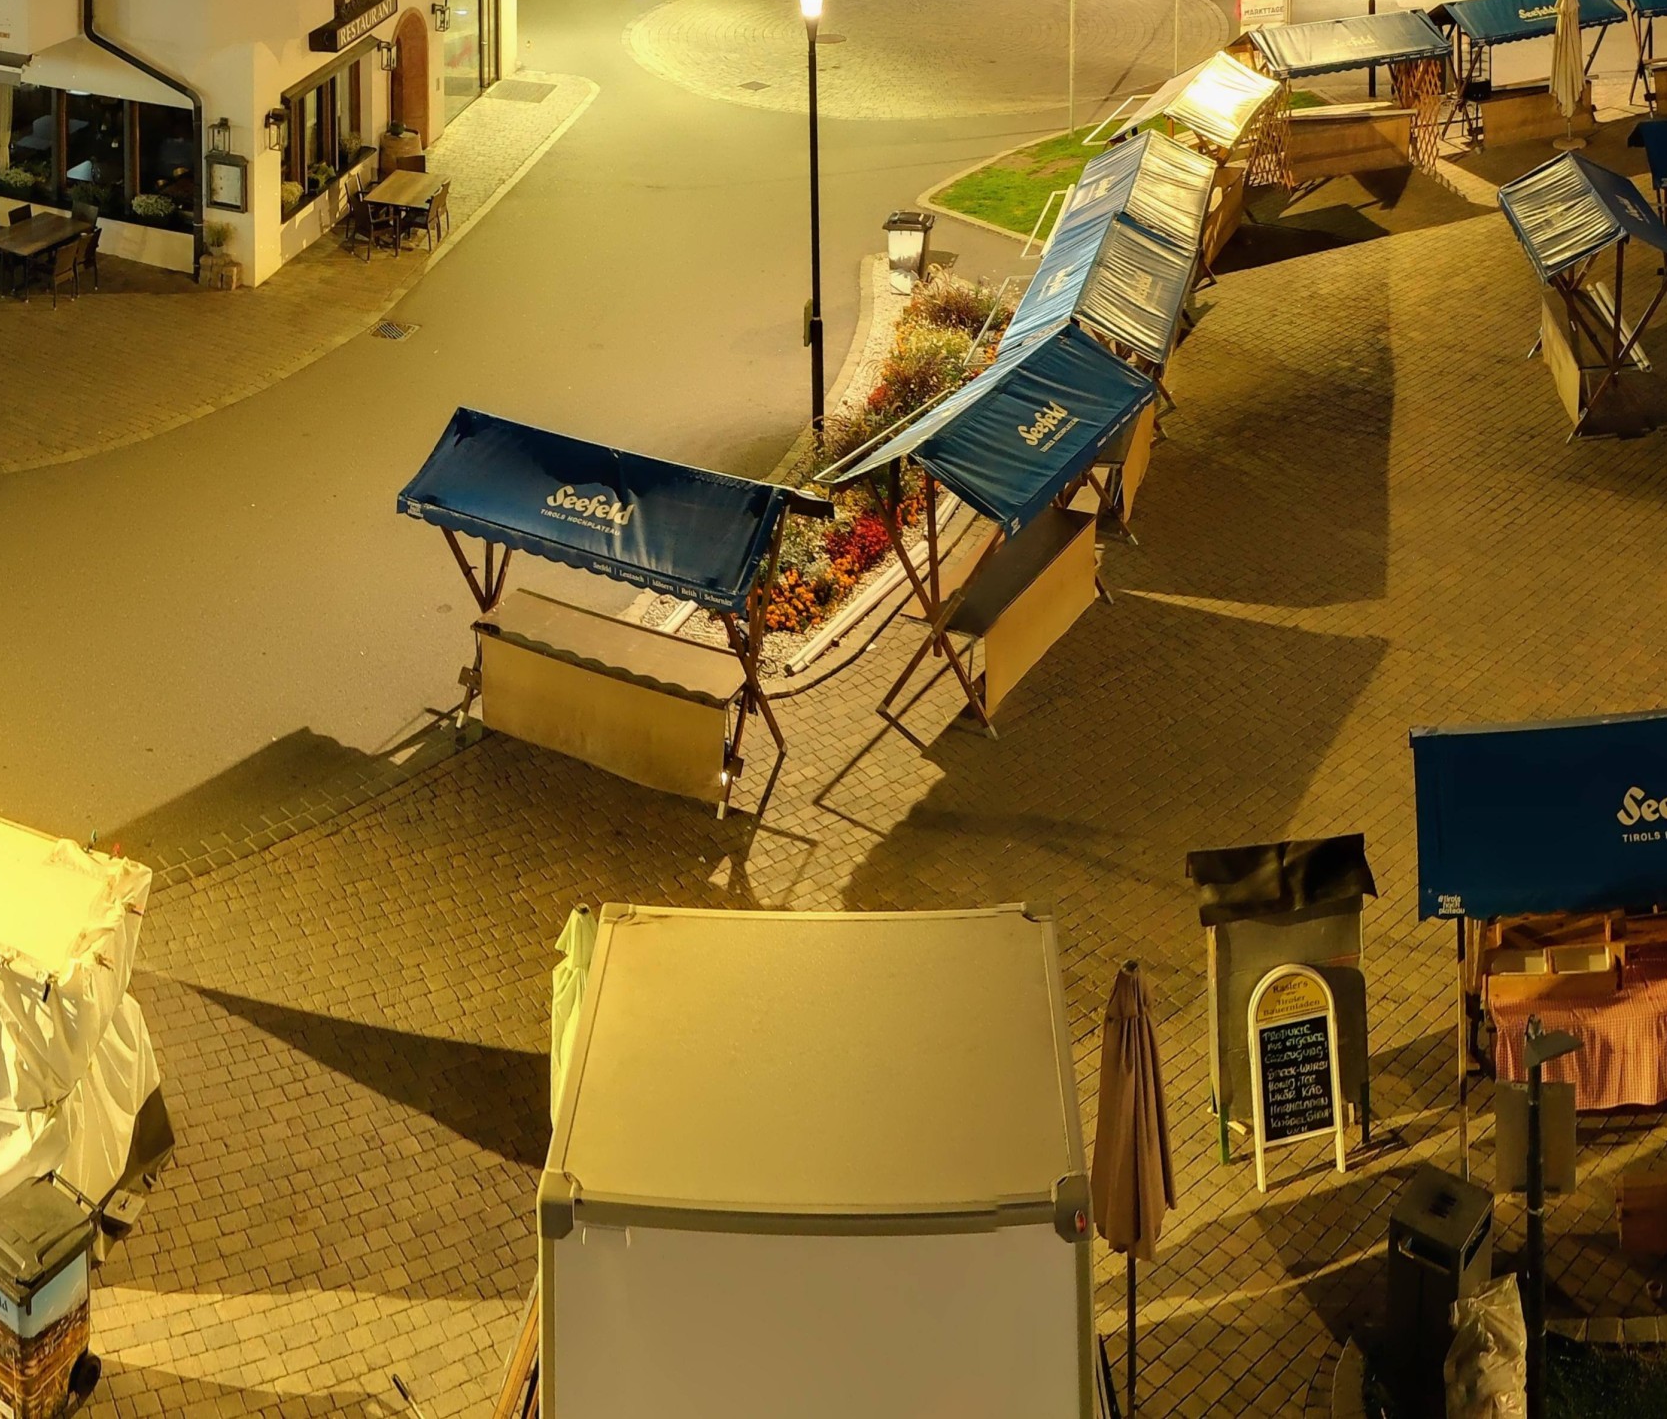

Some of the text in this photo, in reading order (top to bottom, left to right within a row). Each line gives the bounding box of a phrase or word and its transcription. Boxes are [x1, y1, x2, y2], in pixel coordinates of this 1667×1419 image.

[1244, 6, 1285, 16] MARKTTAGE
[1518, 5, 1558, 19] Seefeld
[1017, 400, 1068, 446] Seefeld
[546, 484, 635, 526] Seefeld
[540, 508, 621, 536] TIROLS HOCHPLATEAU
[619, 569, 645, 584] Leutasch
[681, 586, 697, 598] Reith
[1622, 831, 1661, 843] TIROLS
[1437, 894, 1462, 903] #tirols
[1263, 999, 1320, 1016] Bauernladen
[1276, 995, 1306, 1006] Tiroler
[1262, 1024, 1311, 1041] PRODUKTE
[1267, 1041, 1283, 1051] AUS
[1268, 1078, 1296, 1091] HONIG
[1270, 1096, 1329, 1116] MARMELADEN
